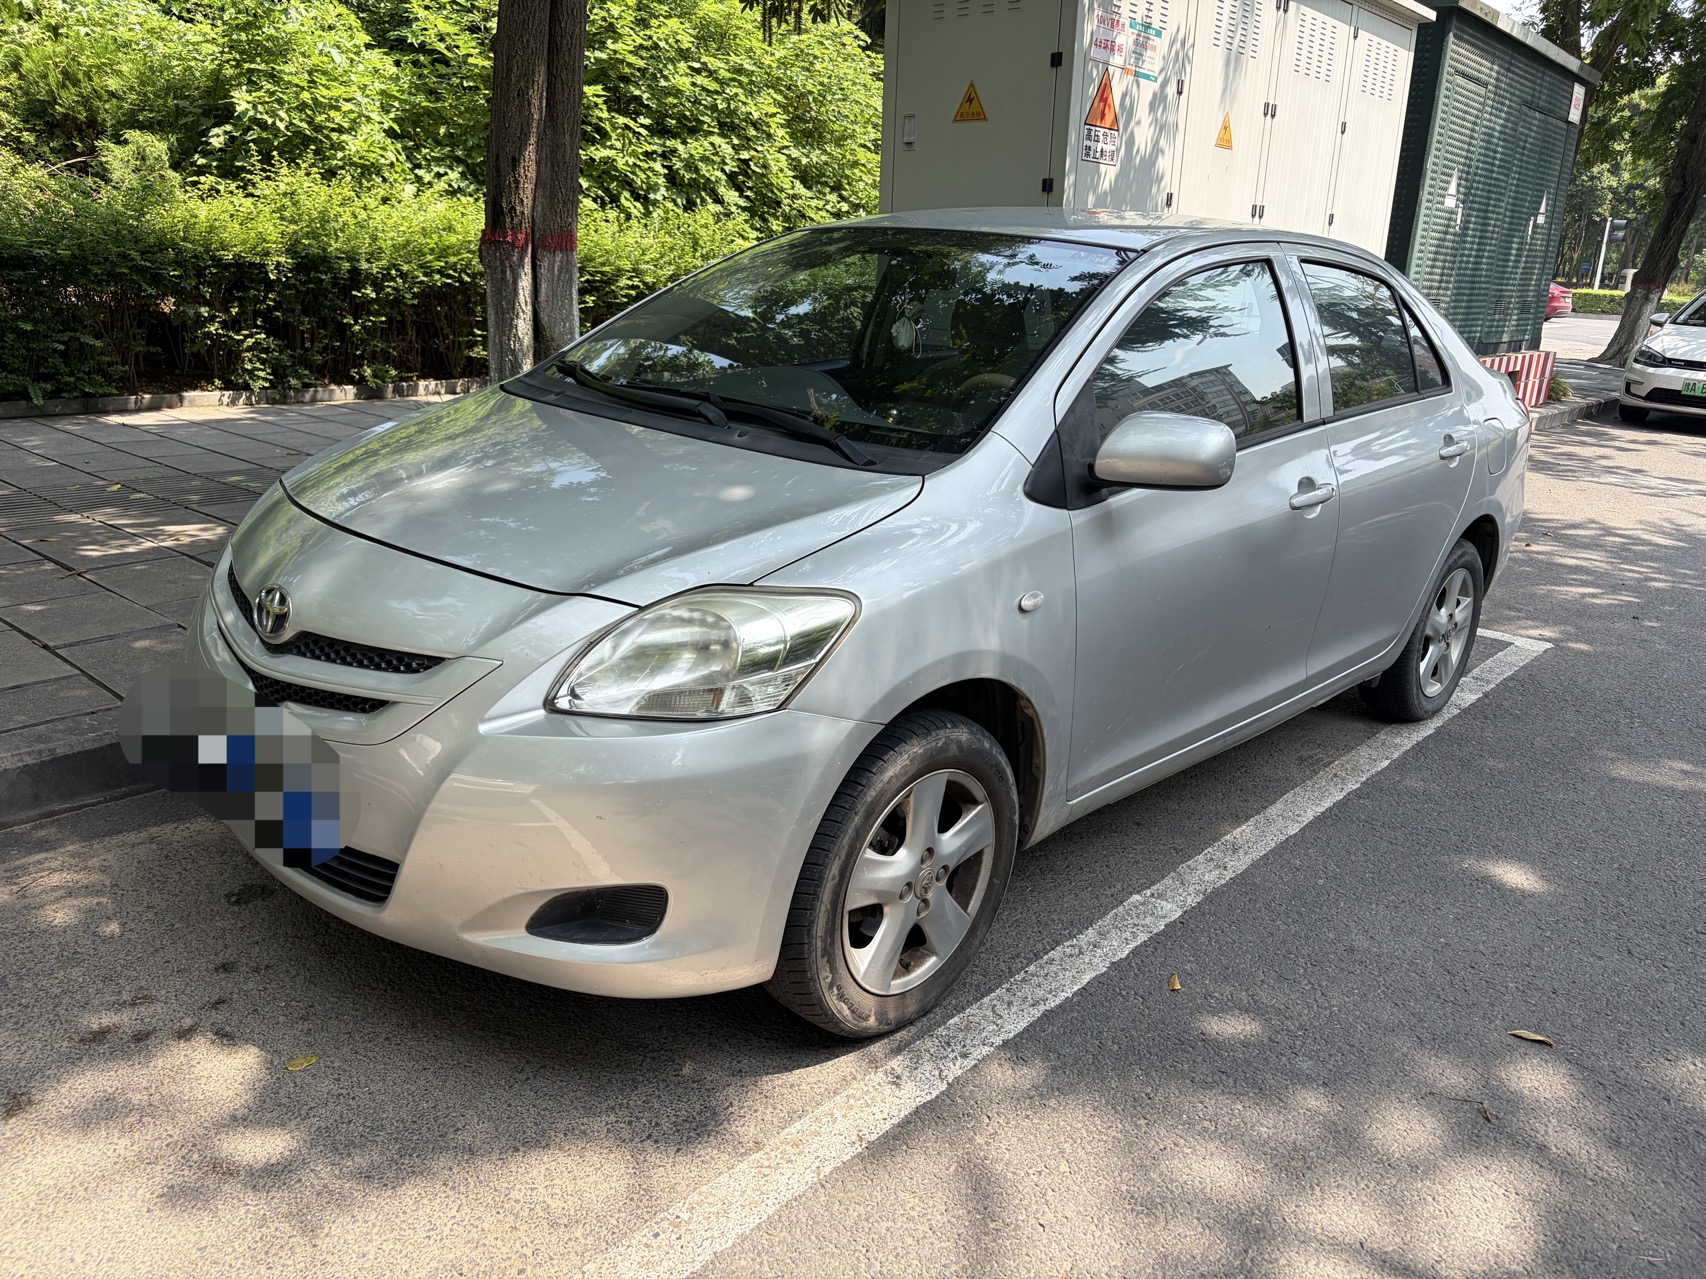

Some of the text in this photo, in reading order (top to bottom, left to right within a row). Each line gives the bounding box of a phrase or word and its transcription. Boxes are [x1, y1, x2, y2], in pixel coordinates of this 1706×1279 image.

[1085, 127, 1116, 146] 高压危险
[1083, 144, 1115, 163] 禁止触摸
